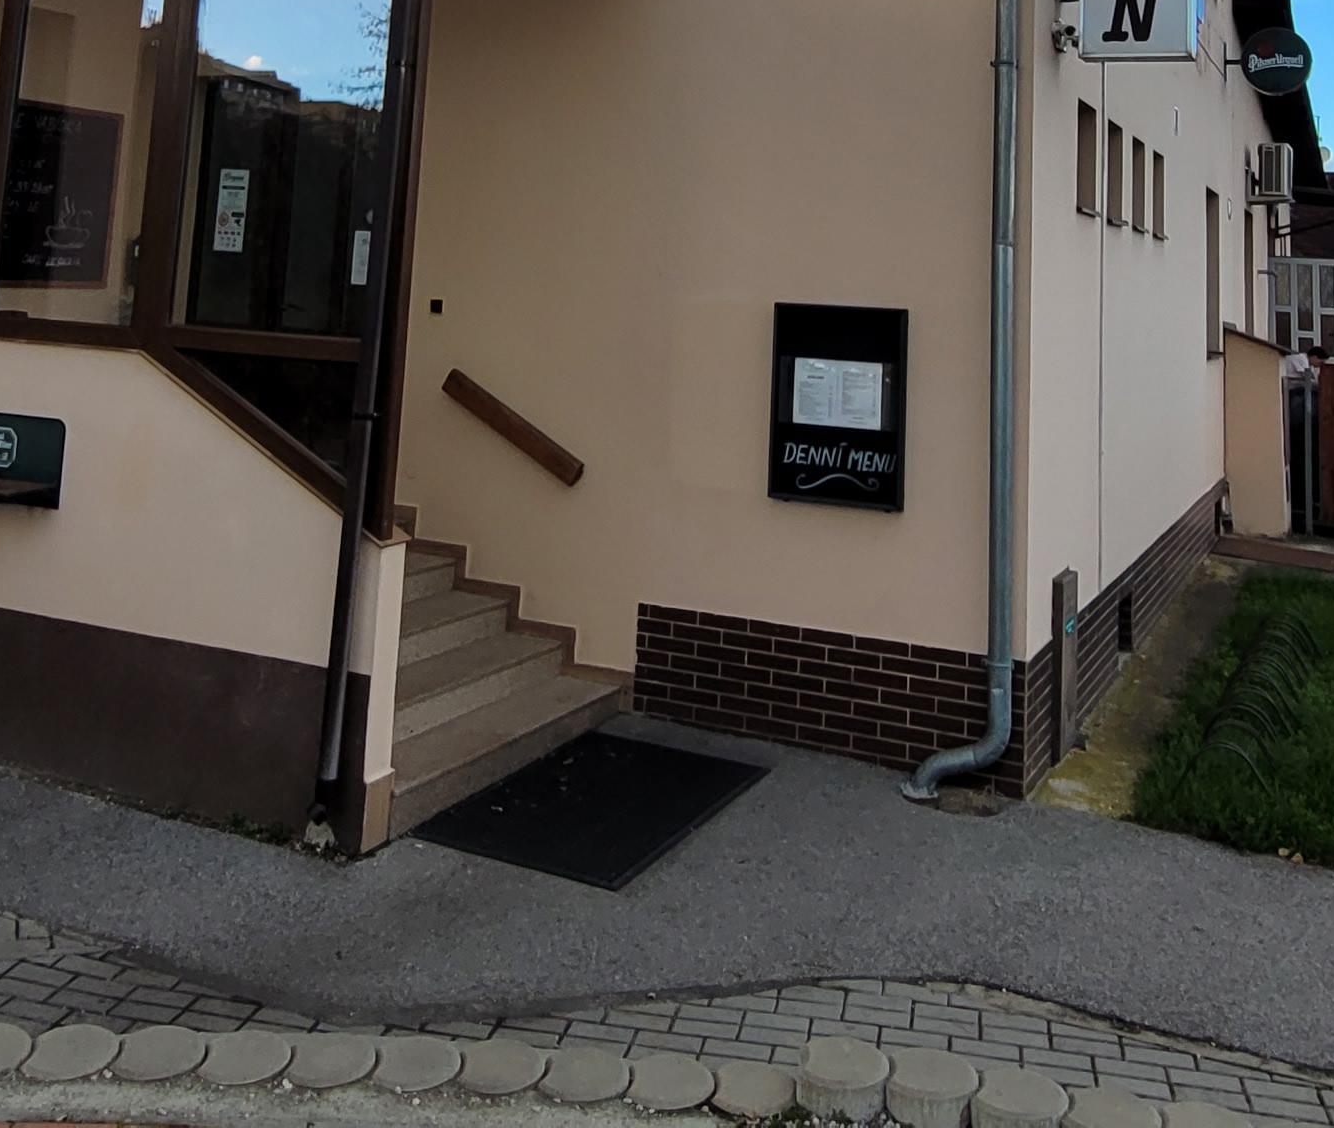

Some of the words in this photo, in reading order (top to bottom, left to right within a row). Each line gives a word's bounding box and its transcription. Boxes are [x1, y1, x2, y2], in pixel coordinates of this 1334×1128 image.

[1248, 53, 1276, 73] Pilsner
[783, 443, 847, 468] DENNÍ
[848, 449, 897, 473] MENU
